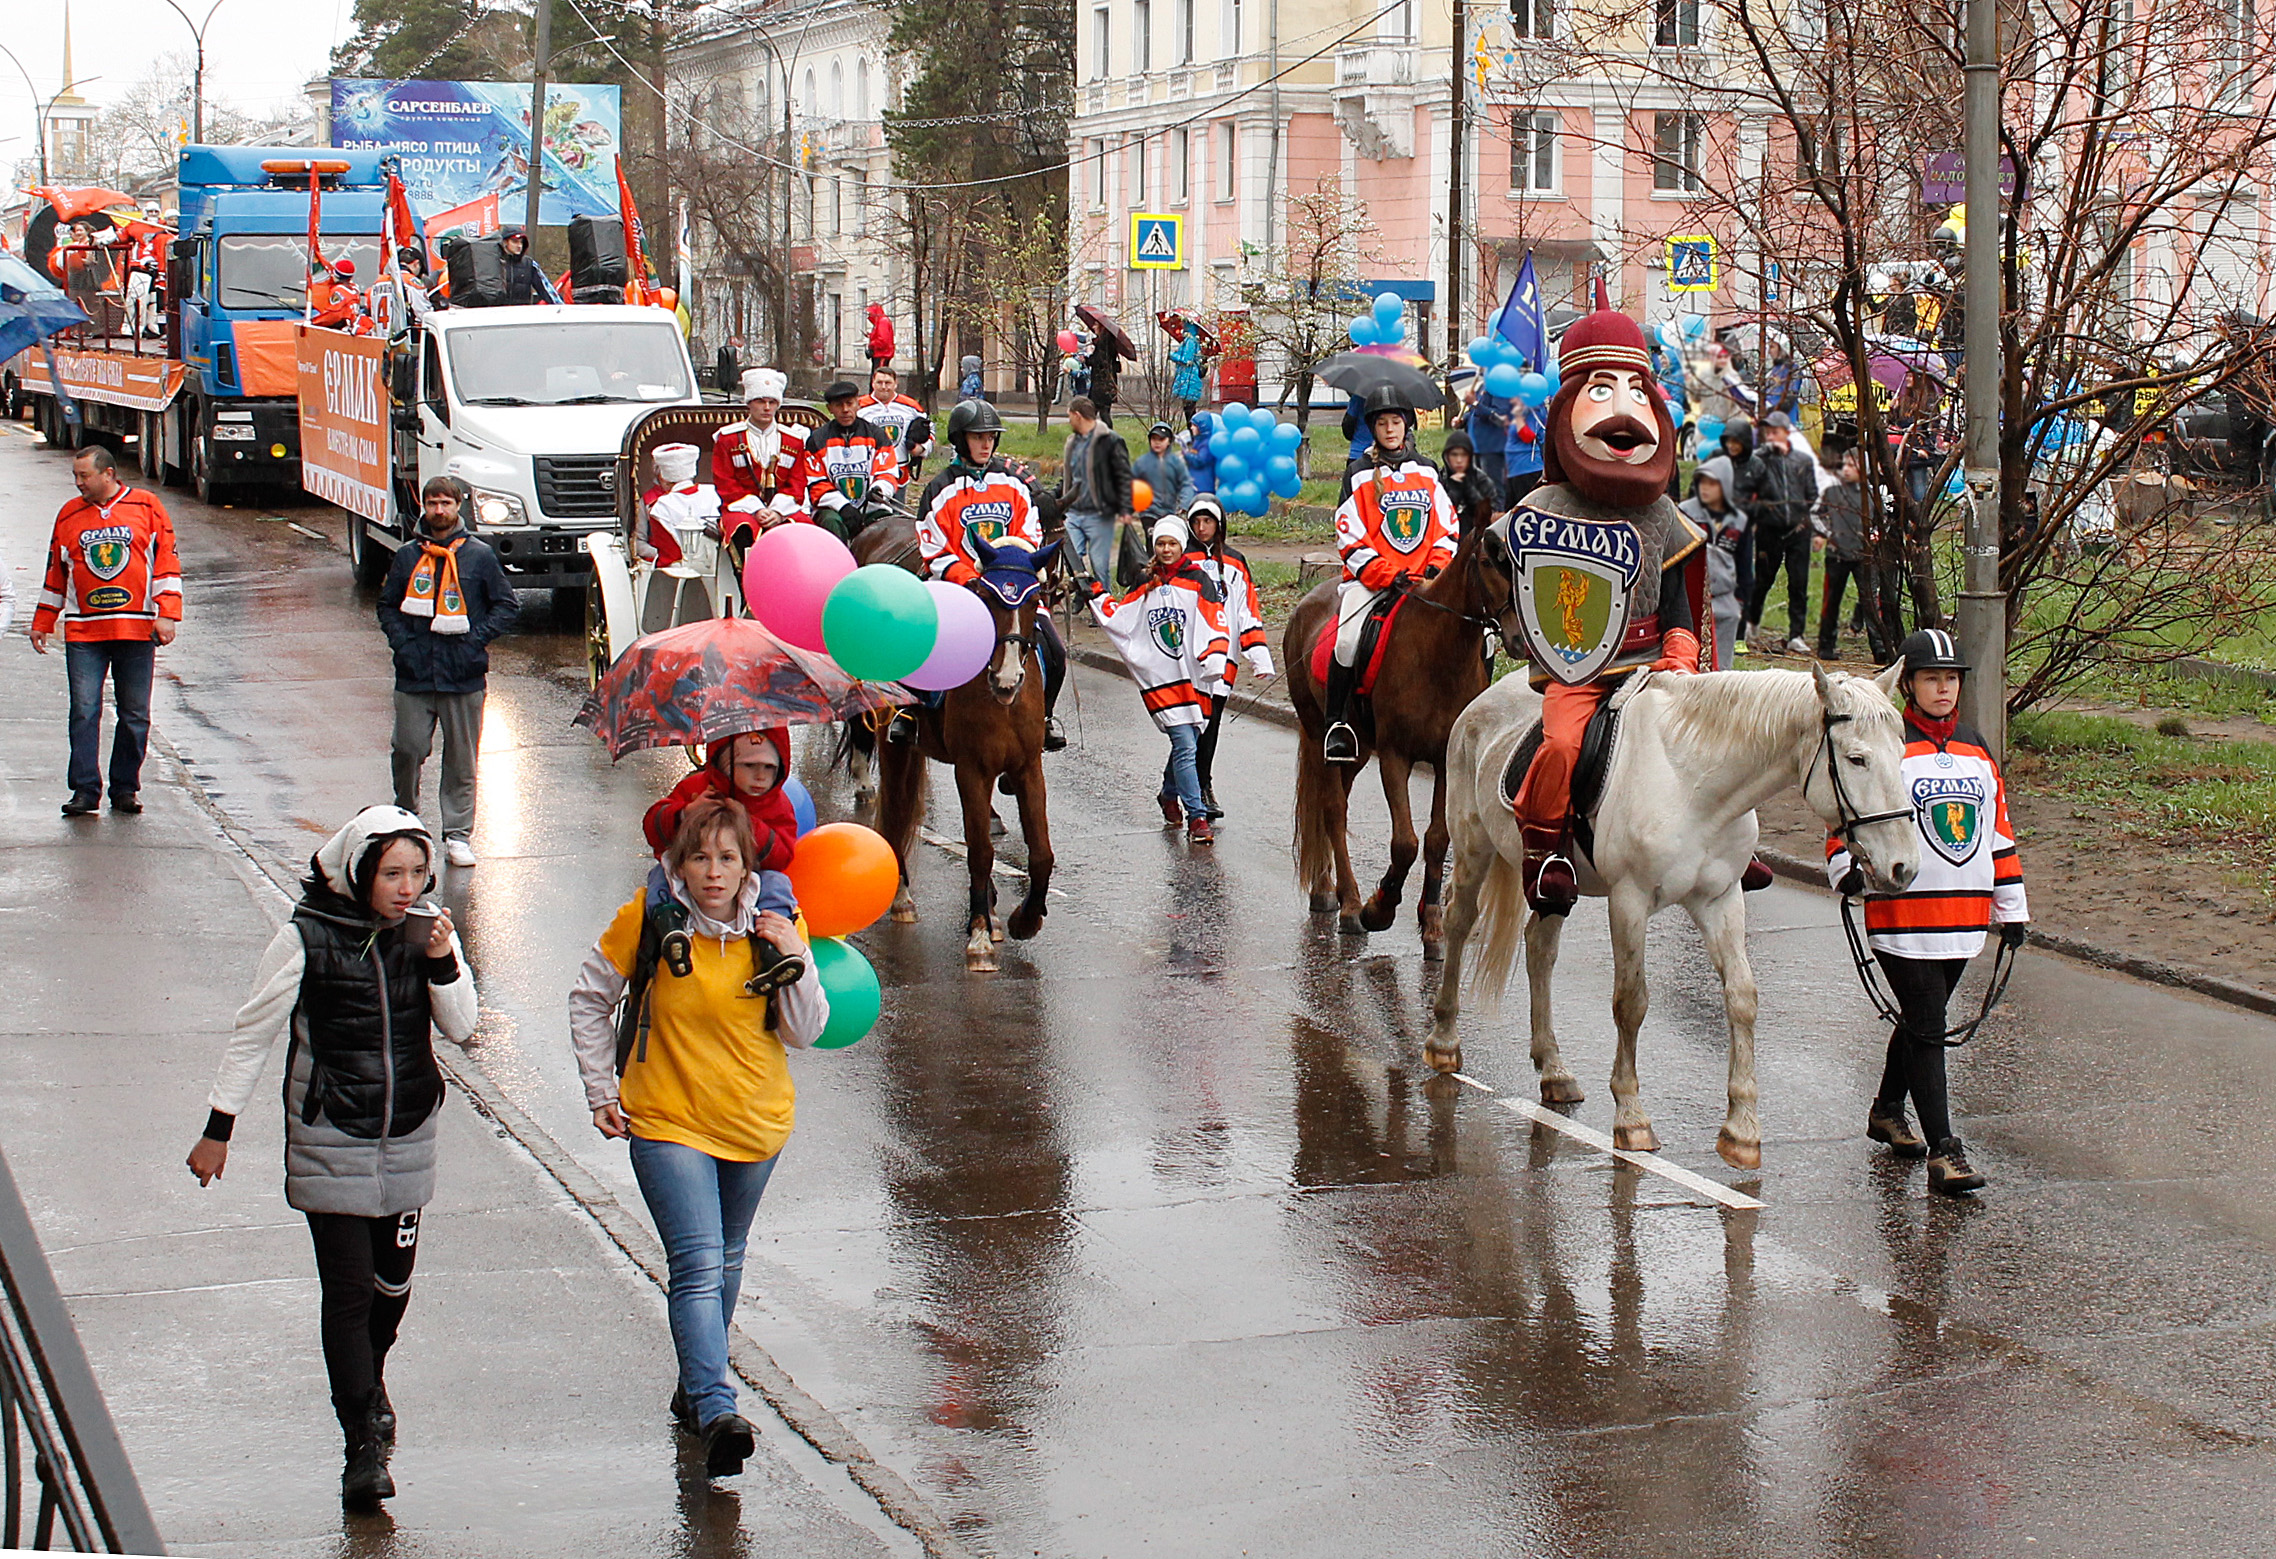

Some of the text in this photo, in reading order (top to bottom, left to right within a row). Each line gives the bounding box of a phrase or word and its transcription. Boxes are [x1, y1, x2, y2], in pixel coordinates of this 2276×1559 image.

[388, 100, 493, 115] САРСЕНБАЕВ
[342, 140, 482, 156] РЫБА МЯСО ПТИЦА
[400, 157, 481, 174] РОДУКТЫ
[407, 189, 434, 200] 9888
